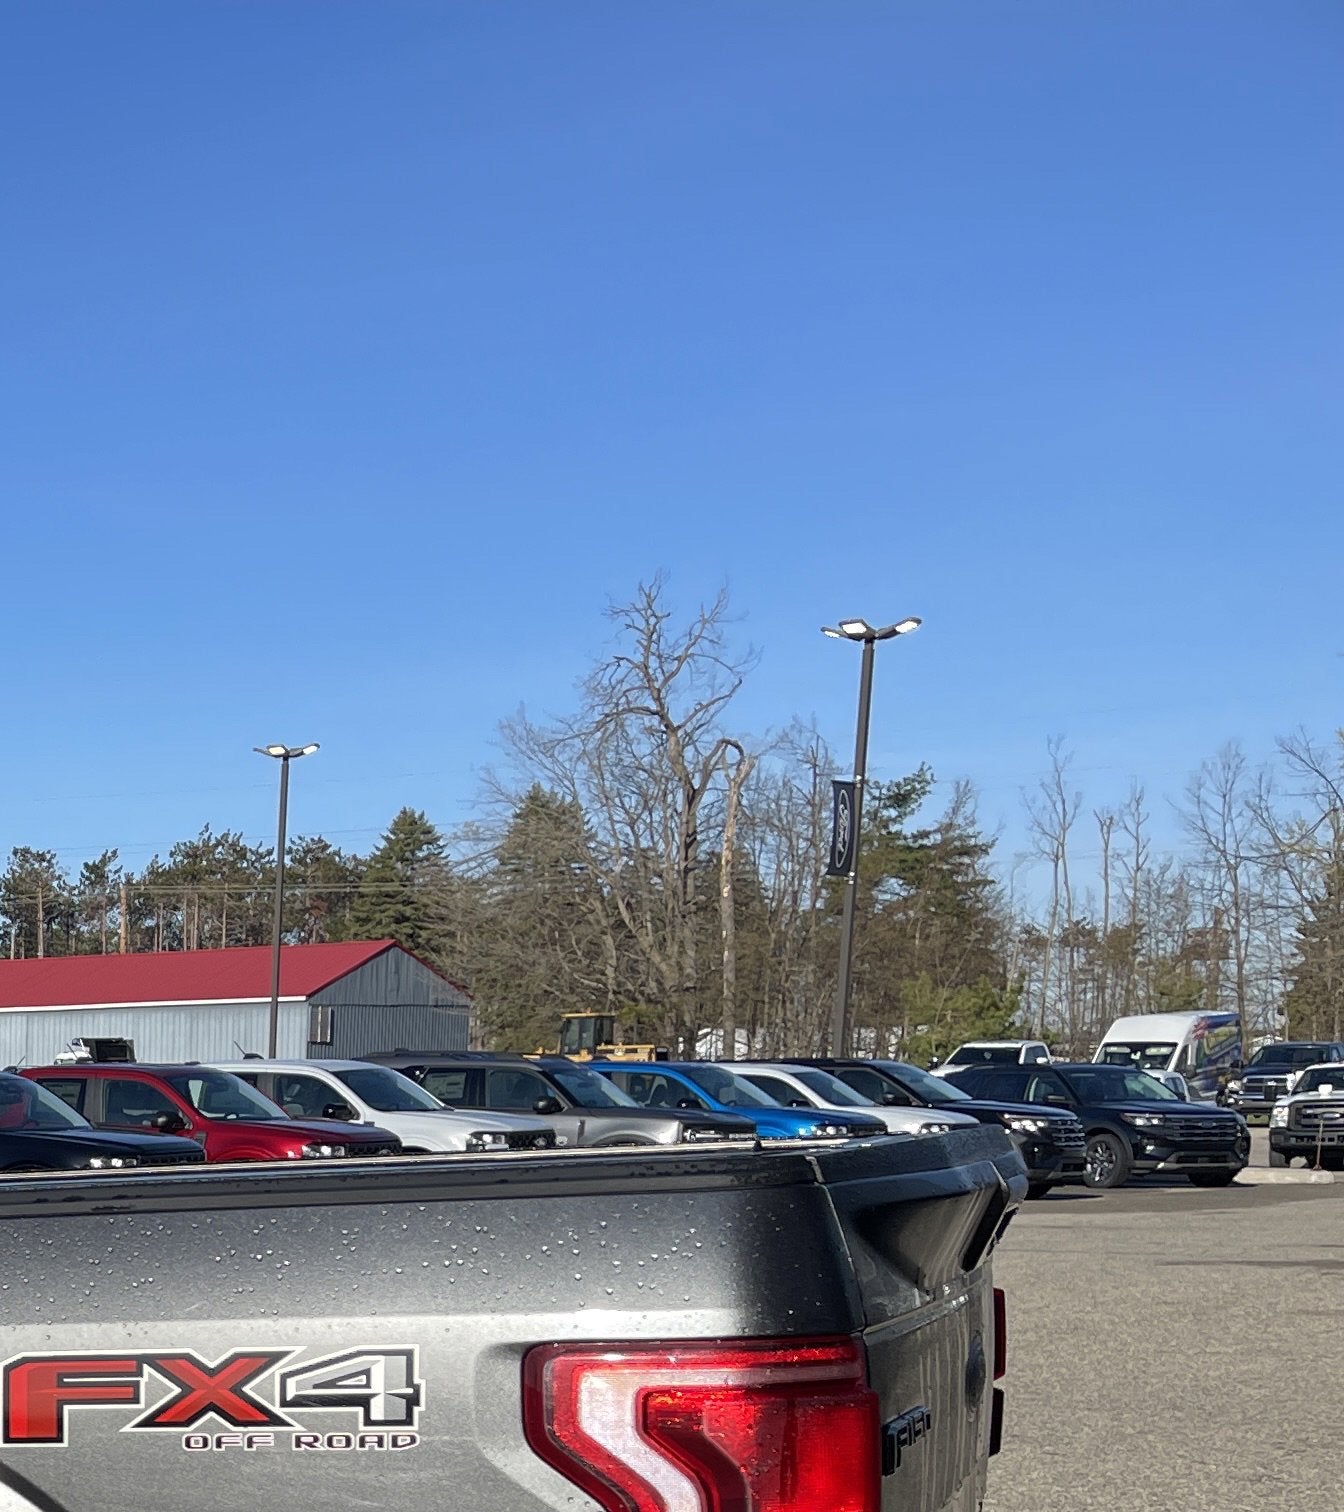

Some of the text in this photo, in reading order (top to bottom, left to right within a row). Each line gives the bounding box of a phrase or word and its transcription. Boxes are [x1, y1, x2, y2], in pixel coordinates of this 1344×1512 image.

[0, 1345, 424, 1447] FX4
[182, 1432, 419, 1452] OFF ROAD
